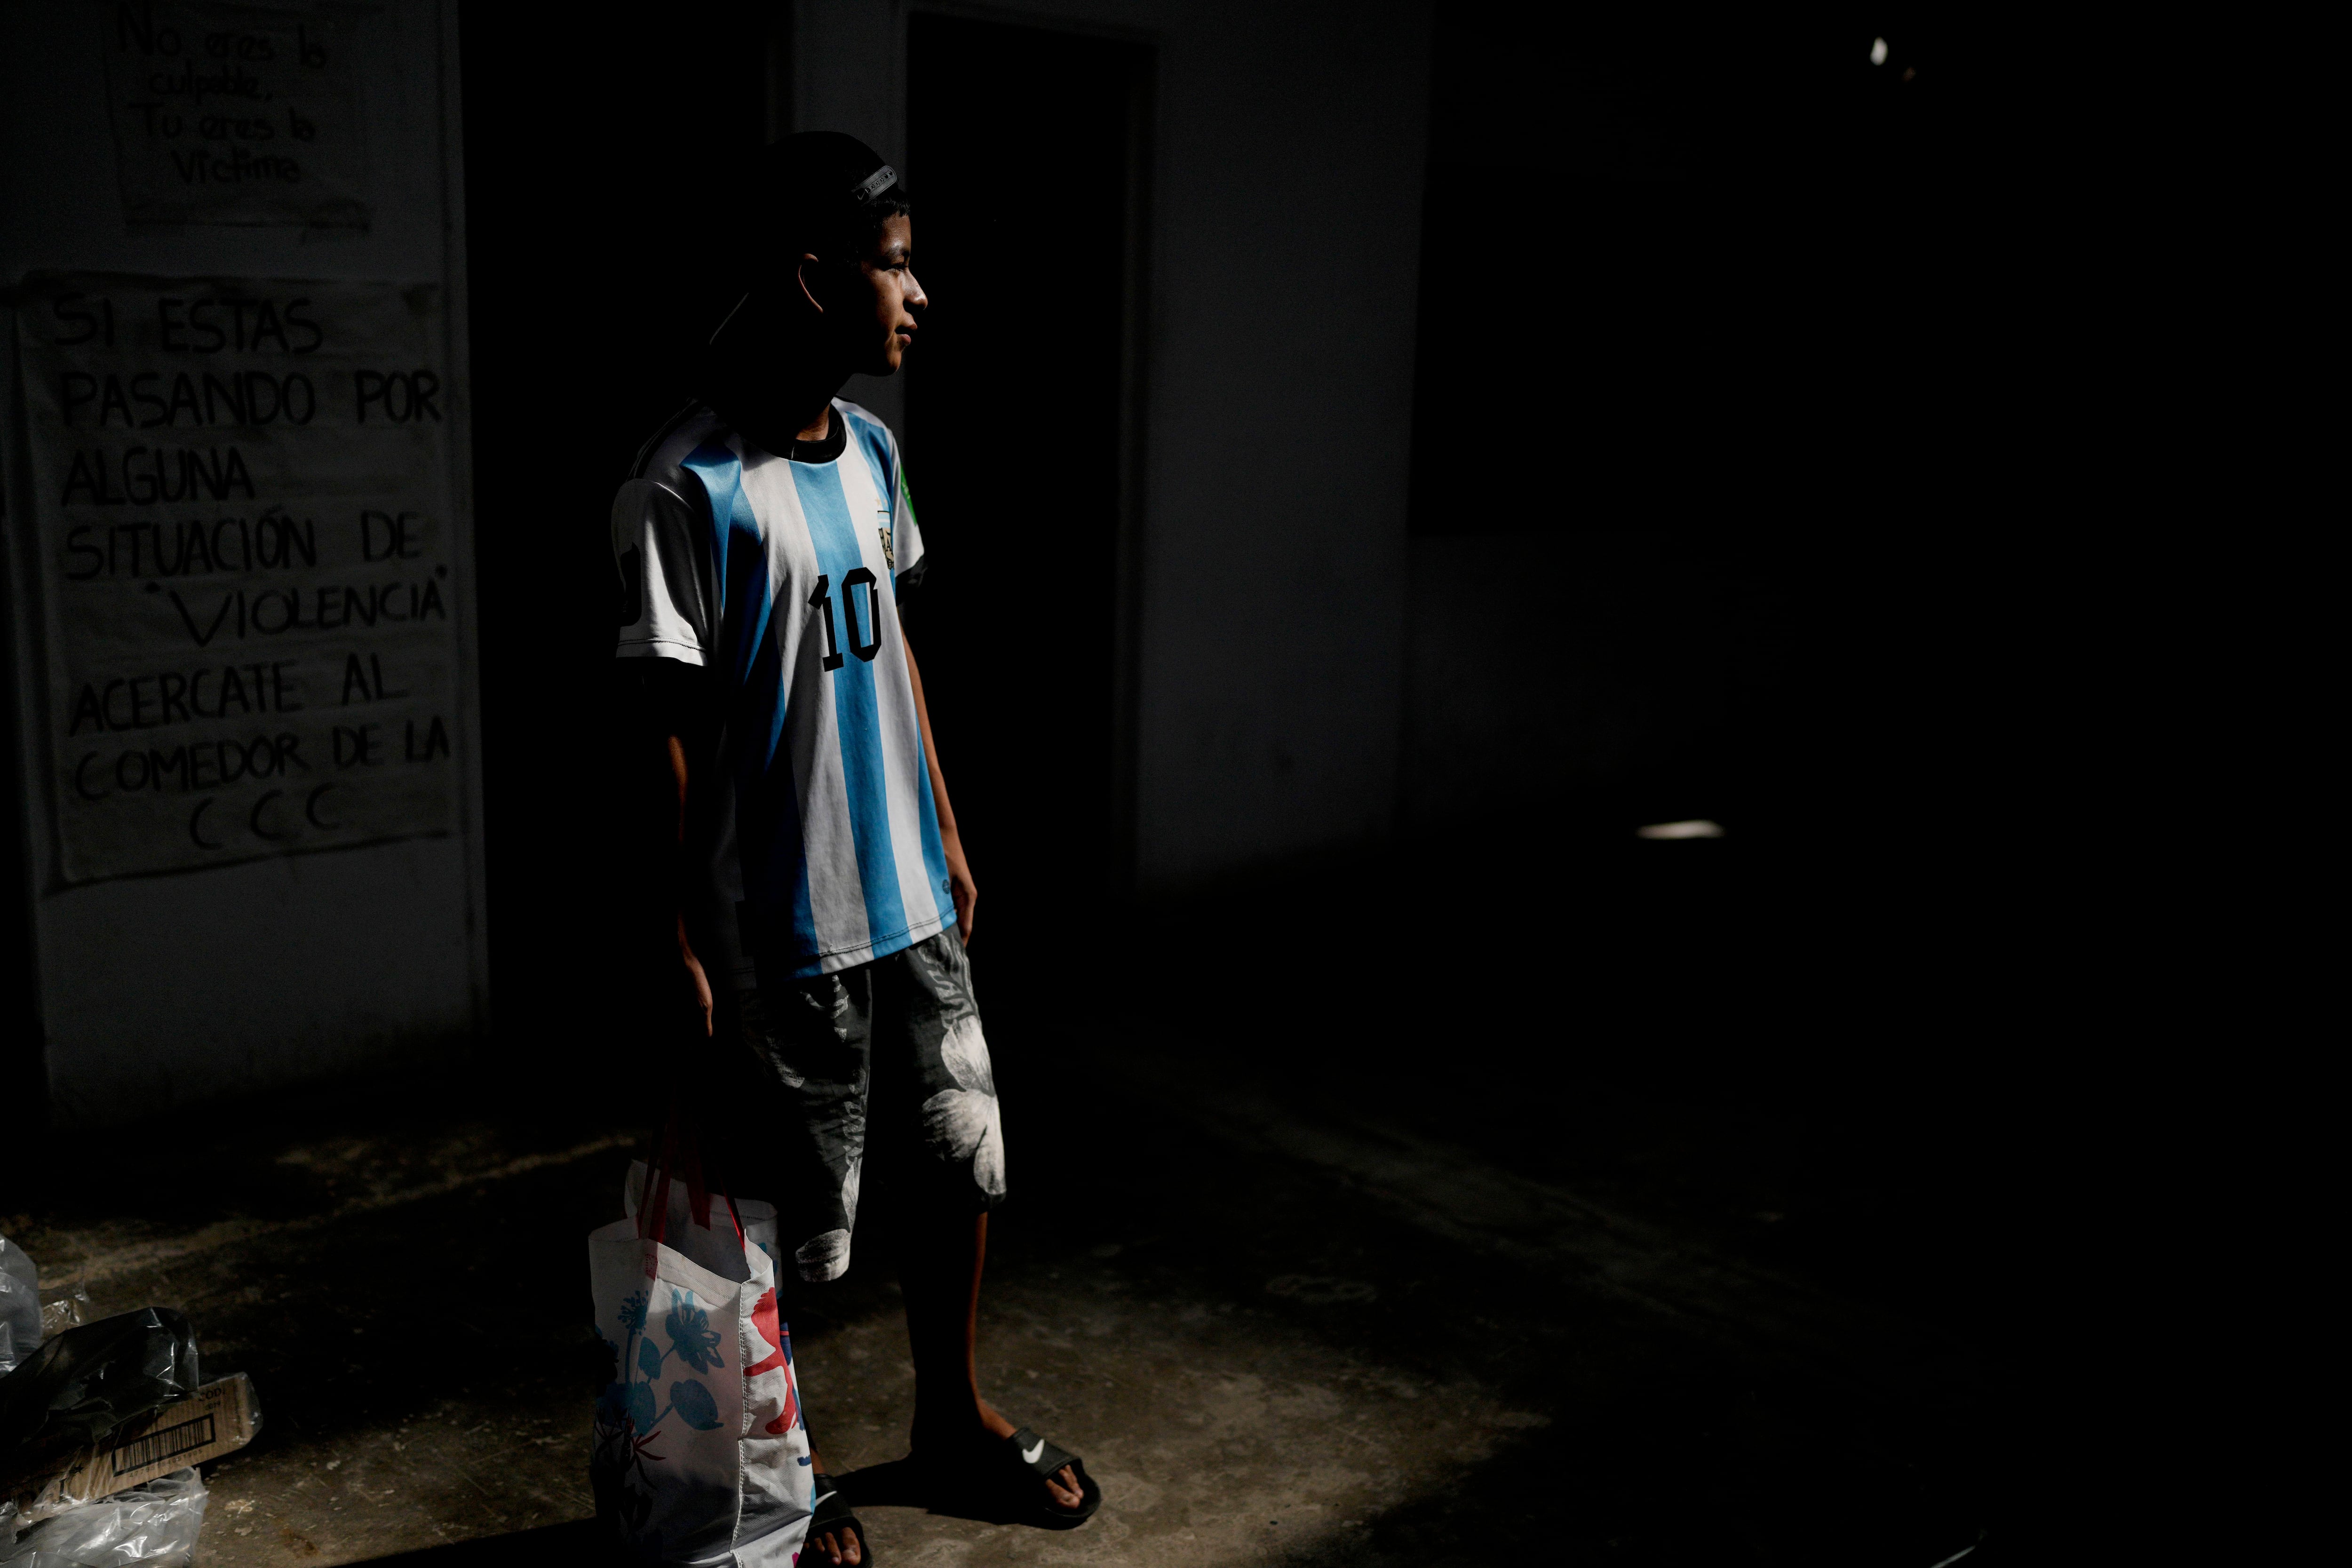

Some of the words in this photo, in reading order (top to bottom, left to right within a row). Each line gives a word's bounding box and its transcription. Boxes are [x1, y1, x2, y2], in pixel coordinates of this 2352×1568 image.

[117, 0, 182, 56] No
[205, 32, 275, 61] eres
[128, 102, 183, 137] Tu
[199, 115, 275, 140] eres
[54, 293, 113, 346] SI
[159, 298, 323, 354] ESTAS
[61, 371, 316, 428] PASANDO
[354, 369, 442, 424] POR
[61, 446, 255, 506] ALGUNA
[66, 505, 317, 581] SITUACIÓN
[361, 510, 422, 561] DE
[808, 567, 882, 672] 10
[69, 661, 302, 737] ACERCATE
[342, 653, 410, 706] AL
[75, 732, 311, 801] COMEDOR
[333, 724, 384, 770] DE
[405, 715, 450, 763] LA
